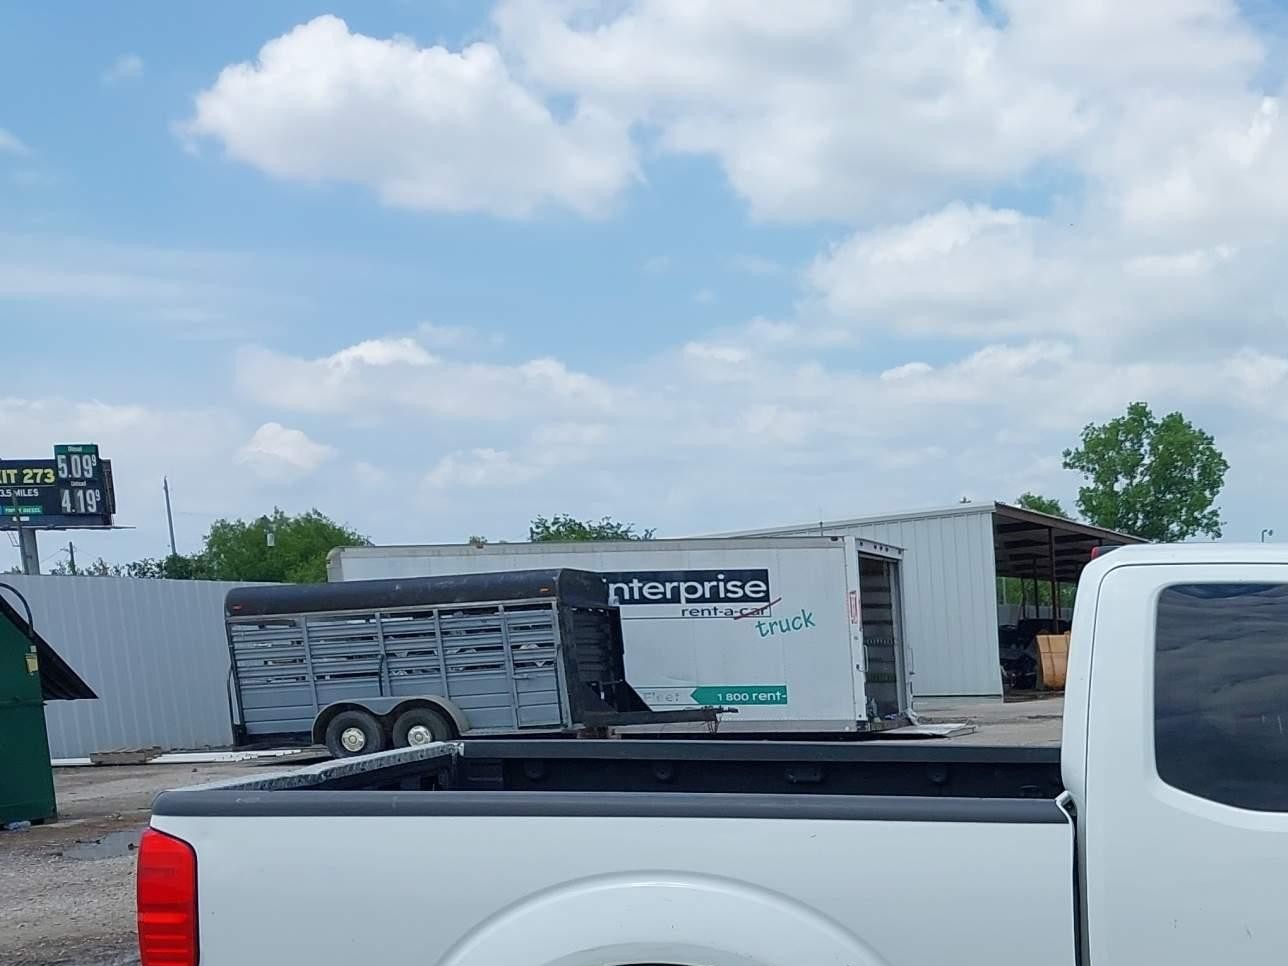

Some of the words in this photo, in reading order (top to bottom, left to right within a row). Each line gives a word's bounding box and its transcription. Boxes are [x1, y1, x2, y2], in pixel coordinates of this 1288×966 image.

[22, 468, 55, 483] 273
[13, 488, 39, 497] MILES
[607, 574, 767, 604] nterprise
[681, 606, 768, 617] rent-a-car
[755, 609, 816, 637] truck
[717, 693, 722, 701] 1
[725, 692, 748, 702] 800
[752, 691, 787, 701] rent-
